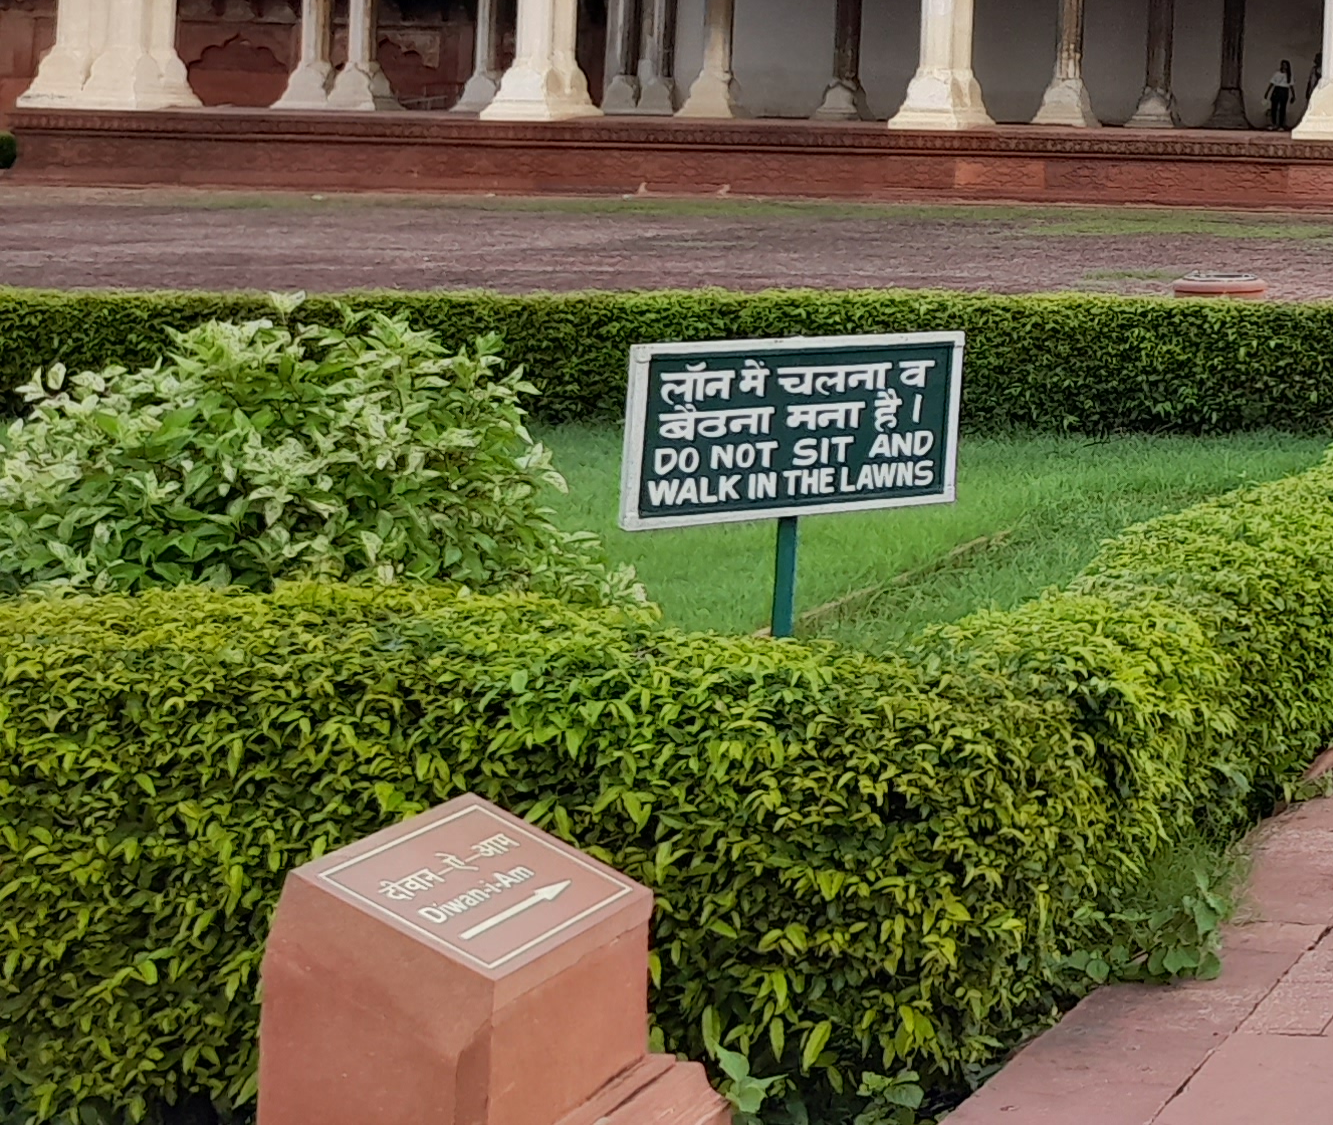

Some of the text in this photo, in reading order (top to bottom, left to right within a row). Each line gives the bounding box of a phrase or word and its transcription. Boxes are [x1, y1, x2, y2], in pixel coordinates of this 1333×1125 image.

[660, 359, 935, 405] लॉन में चलना व
[659, 403, 775, 441] बैठना
[786, 401, 866, 430] मना
[874, 388, 903, 432] है
[654, 430, 934, 475] DO NOT SIT AND
[648, 460, 934, 506] WALK IN THE LAWNS
[418, 866, 535, 923] Diwan-i-Am
